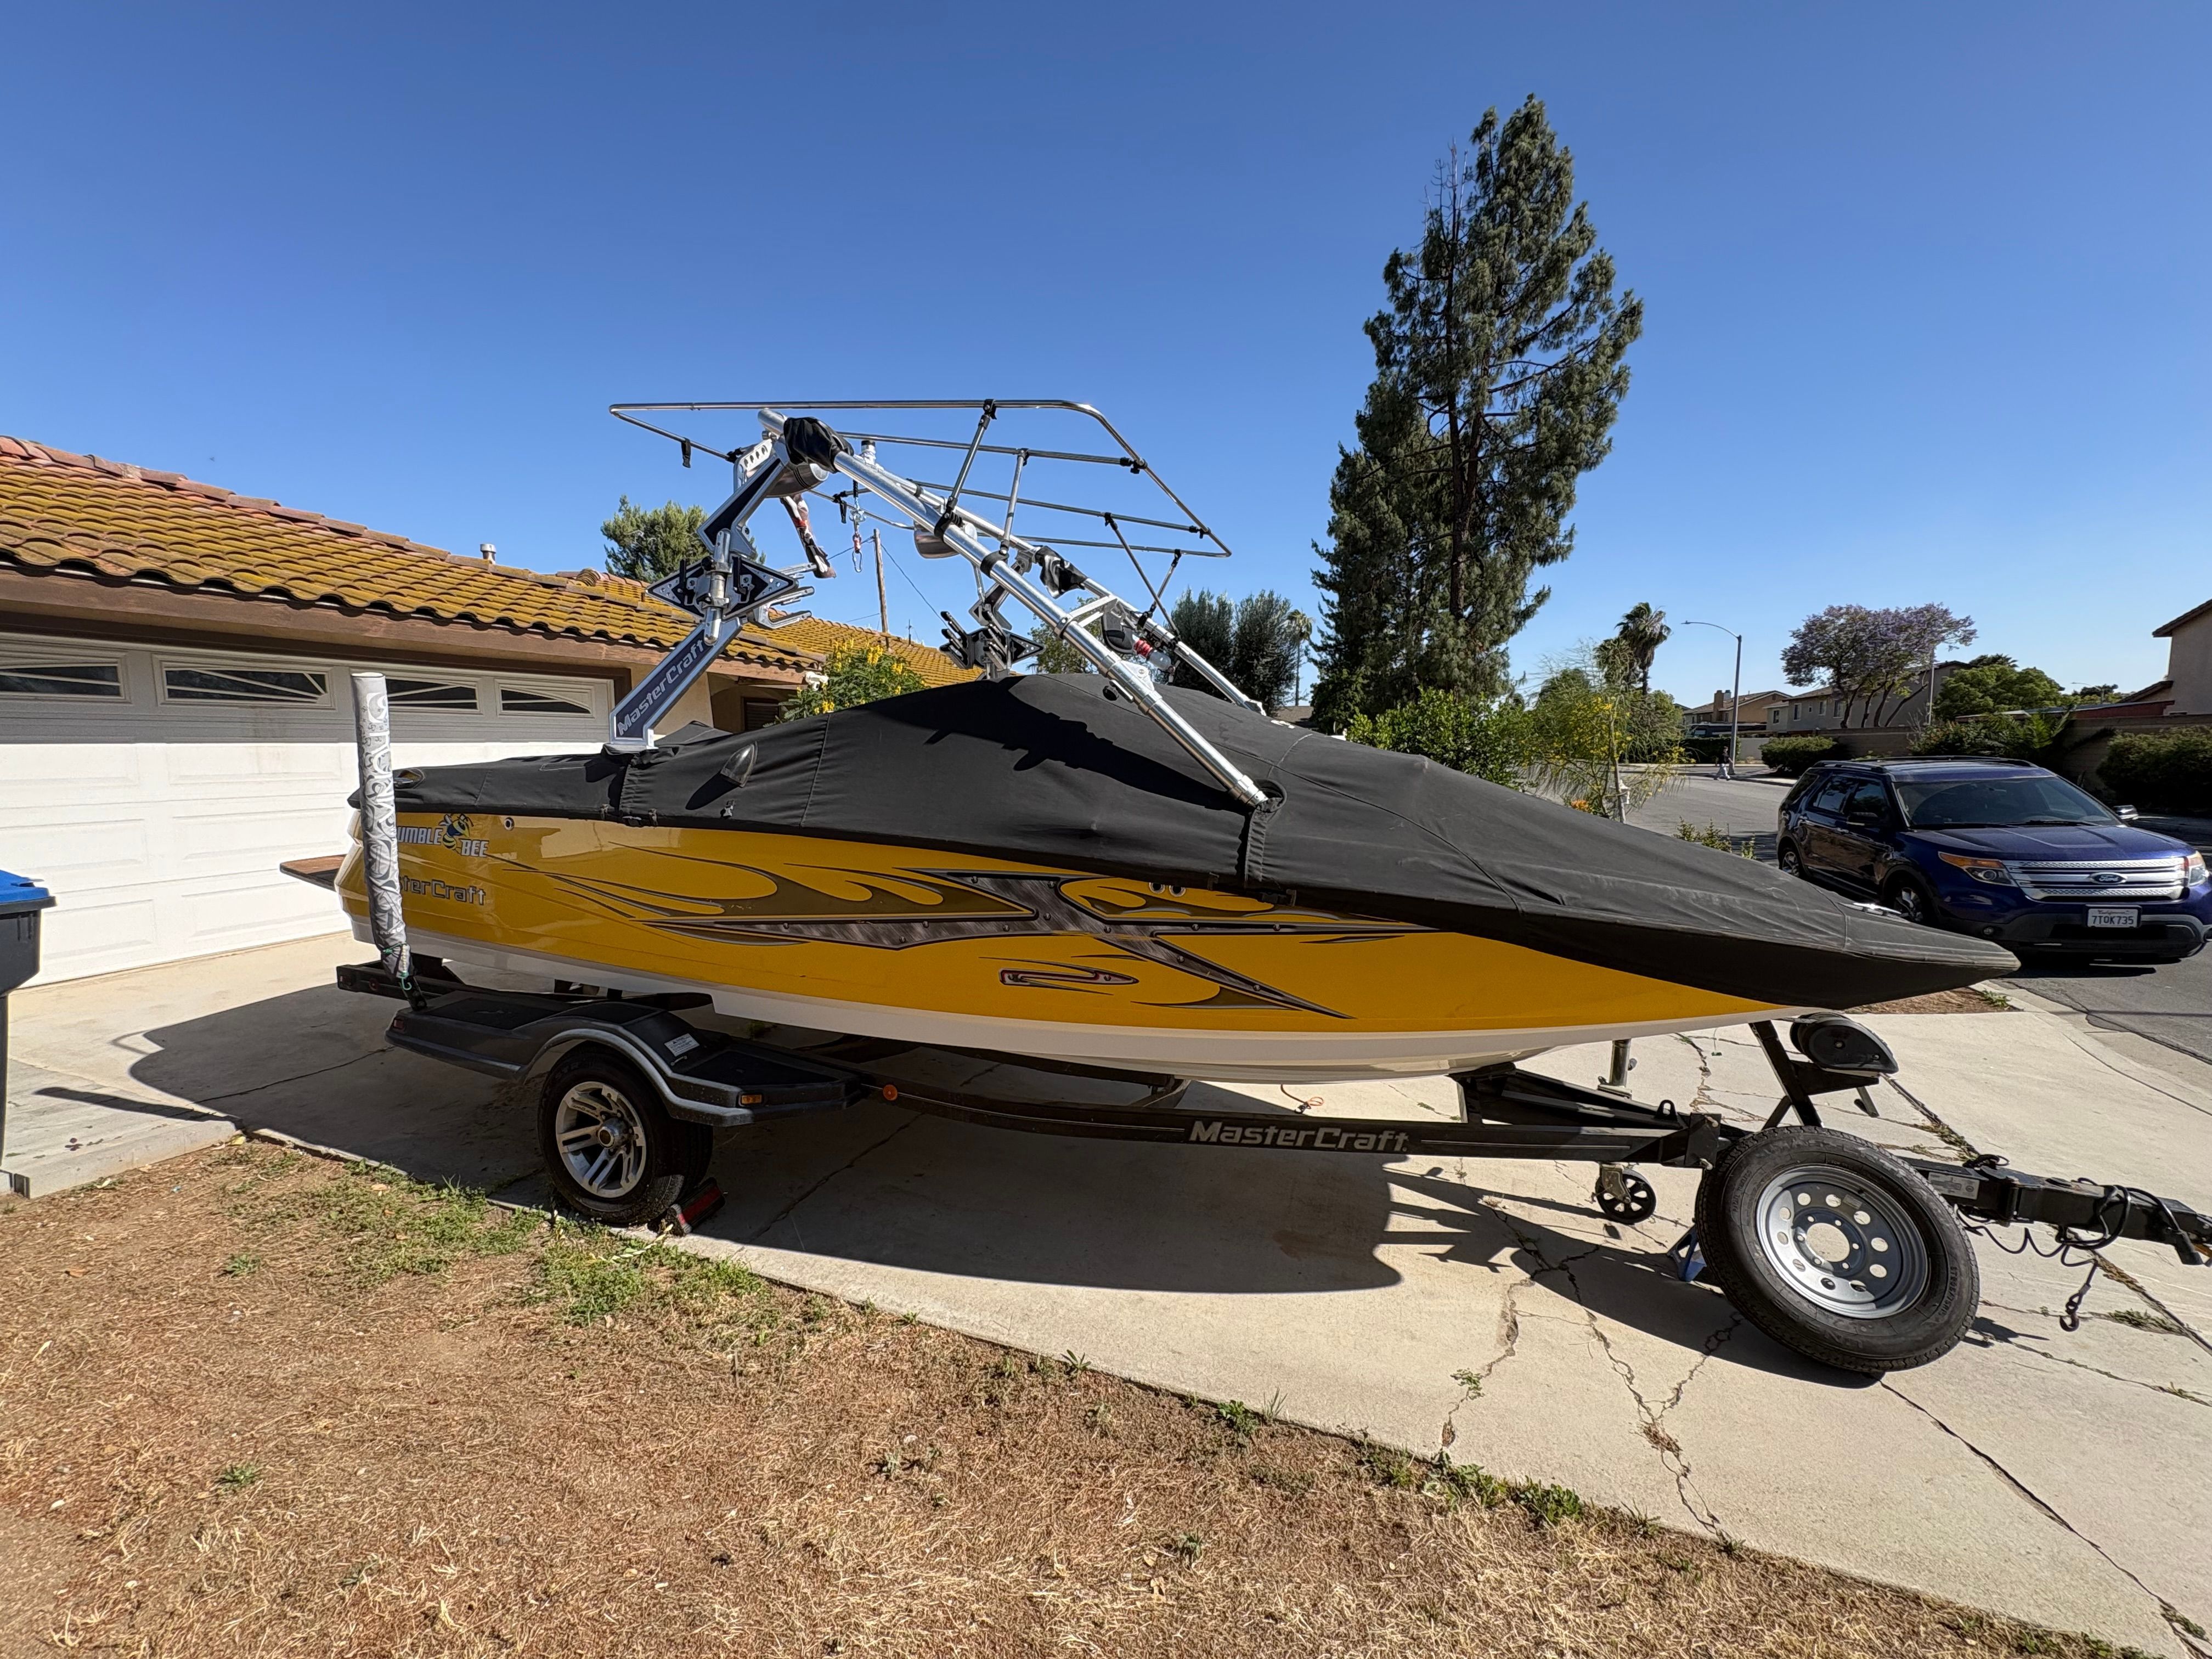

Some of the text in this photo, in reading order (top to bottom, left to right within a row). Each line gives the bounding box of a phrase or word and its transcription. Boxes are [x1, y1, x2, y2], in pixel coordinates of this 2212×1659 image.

[617, 639, 704, 736] MasterCraft
[397, 826, 443, 845] UMBLE
[460, 839, 489, 857] BEE
[399, 876, 486, 905] terCraft
[1189, 1120, 1408, 1152] MasterCraft
